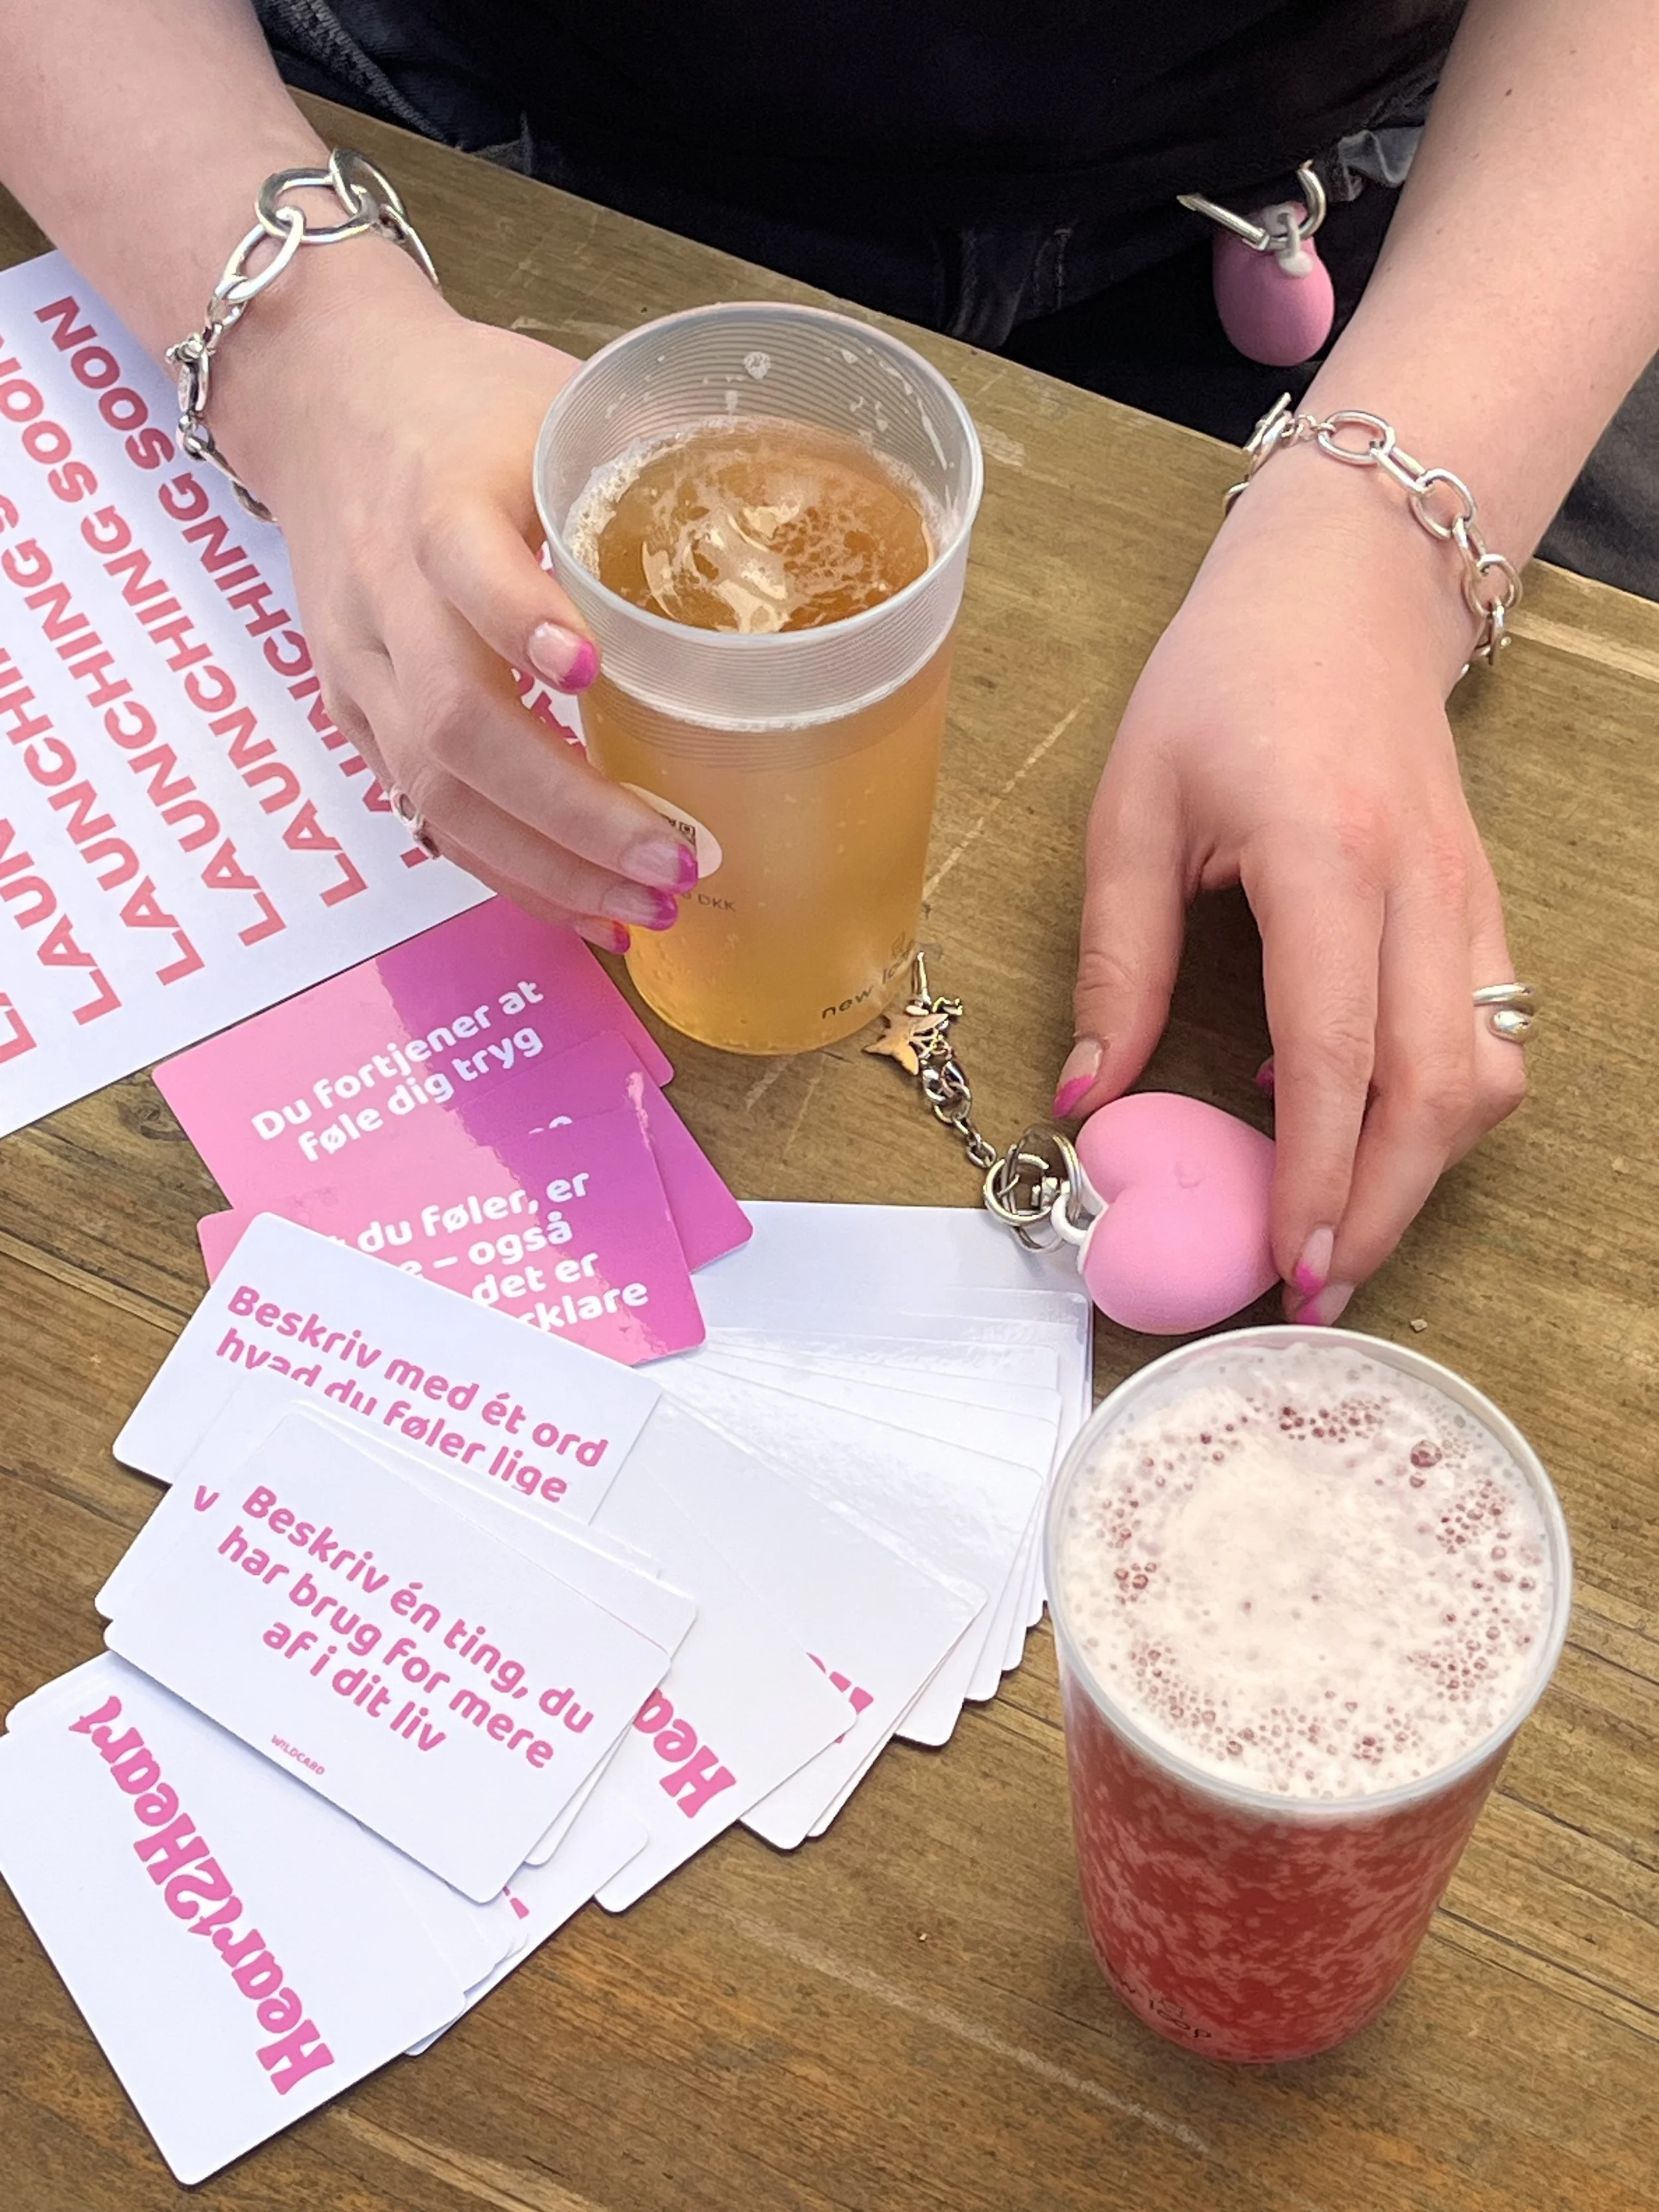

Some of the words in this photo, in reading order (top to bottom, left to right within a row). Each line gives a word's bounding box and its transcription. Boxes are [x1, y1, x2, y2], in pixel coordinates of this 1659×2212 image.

[0, 337, 99, 502] SOO
[33, 297, 177, 469] SOON
[1, 538, 287, 946] LAUNCHING
[80, 504, 368, 907] LAUNCHING
[697, 893, 737, 913] DKK
[250, 1098, 313, 1141] Du
[313, 1005, 491, 1110] fortjener
[498, 982, 543, 1015] at
[822, 984, 874, 1020] new
[297, 1108, 384, 1162] føle
[387, 1072, 455, 1116] dig
[452, 1028, 544, 1082] tryg
[357, 1220, 413, 1254] du
[421, 1189, 539, 1238] føler,
[546, 1172, 590, 1203] er
[467, 1211, 573, 1266] også
[471, 1266, 547, 1307] det
[554, 1253, 599, 1284] er
[216, 1327, 323, 1387] hvad
[323, 1378, 378, 1416] du
[383, 1400, 488, 1465] føler
[488, 1445, 569, 1503] lige
[228, 1284, 382, 1370] Beskriv
[384, 1358, 480, 1412] med
[481, 1392, 526, 1435] ét
[532, 1422, 609, 1467] ord
[217, 1525, 291, 1585] har
[289, 1572, 383, 1658] brug
[383, 1637, 451, 1694] for
[448, 1688, 555, 1769] mere
[242, 1485, 391, 1594] Beskriv
[390, 1581, 442, 1633] én
[443, 1618, 528, 1700] ting,
[538, 1687, 595, 1735] du
[262, 1621, 319, 1661] af
[309, 1645, 334, 1677] i
[331, 1667, 392, 1718] dit
[390, 1700, 447, 1753] liv
[271, 1733, 325, 1775] WILDCARD
[69, 1695, 336, 2096] Heart2Heart
